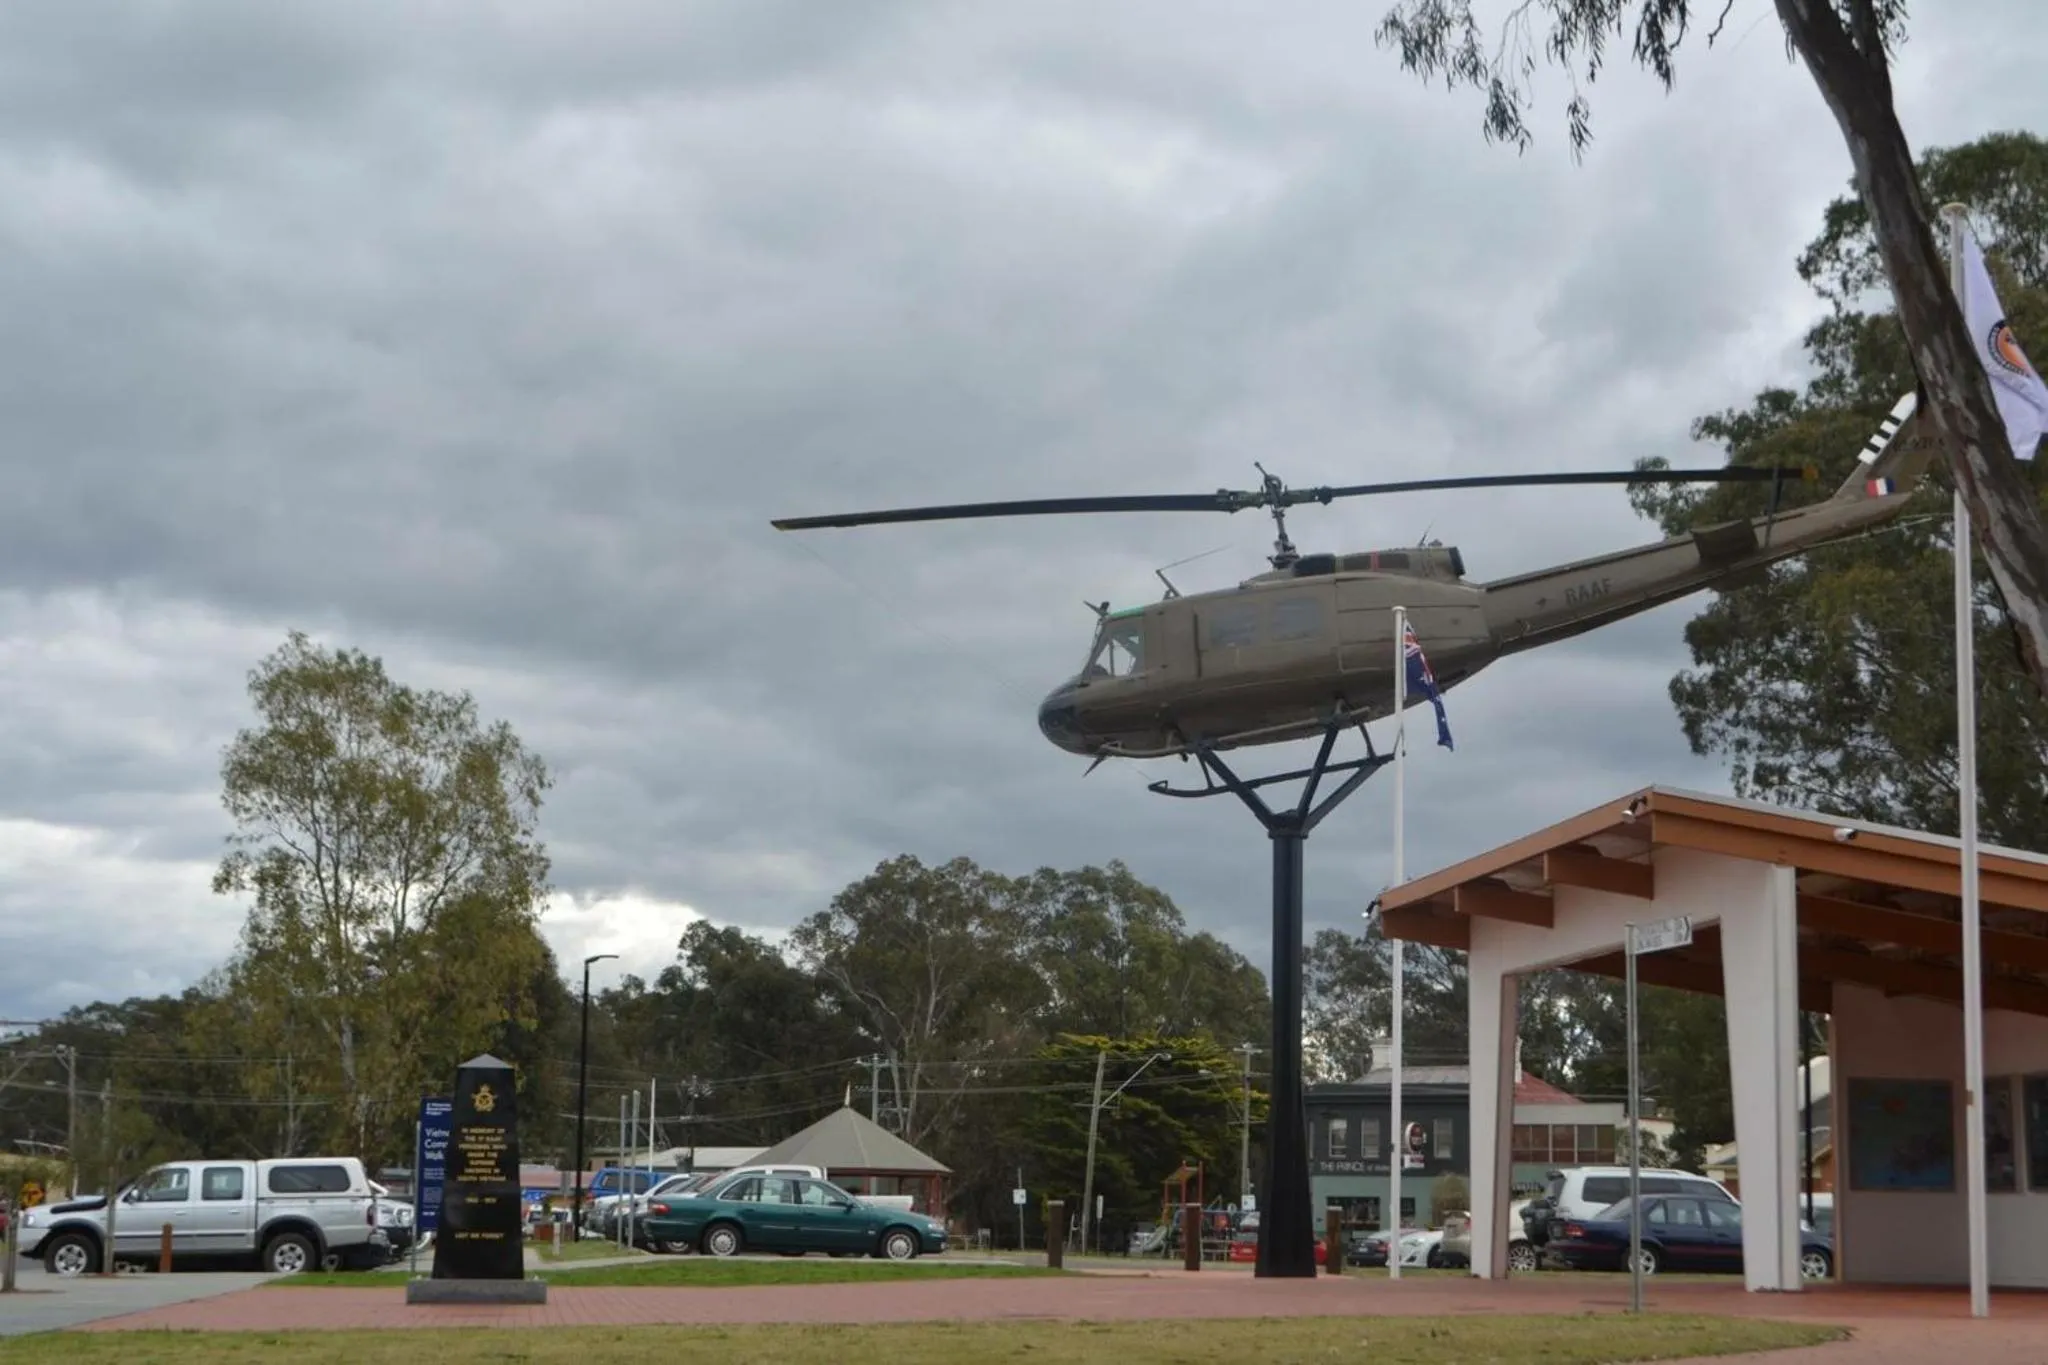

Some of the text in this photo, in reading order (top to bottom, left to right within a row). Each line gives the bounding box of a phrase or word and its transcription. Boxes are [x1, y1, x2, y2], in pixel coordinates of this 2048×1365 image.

[1565, 578, 1612, 605] RAAF
[1320, 1161, 1335, 1172] THE
[1336, 1161, 1365, 1172] PRINCE
